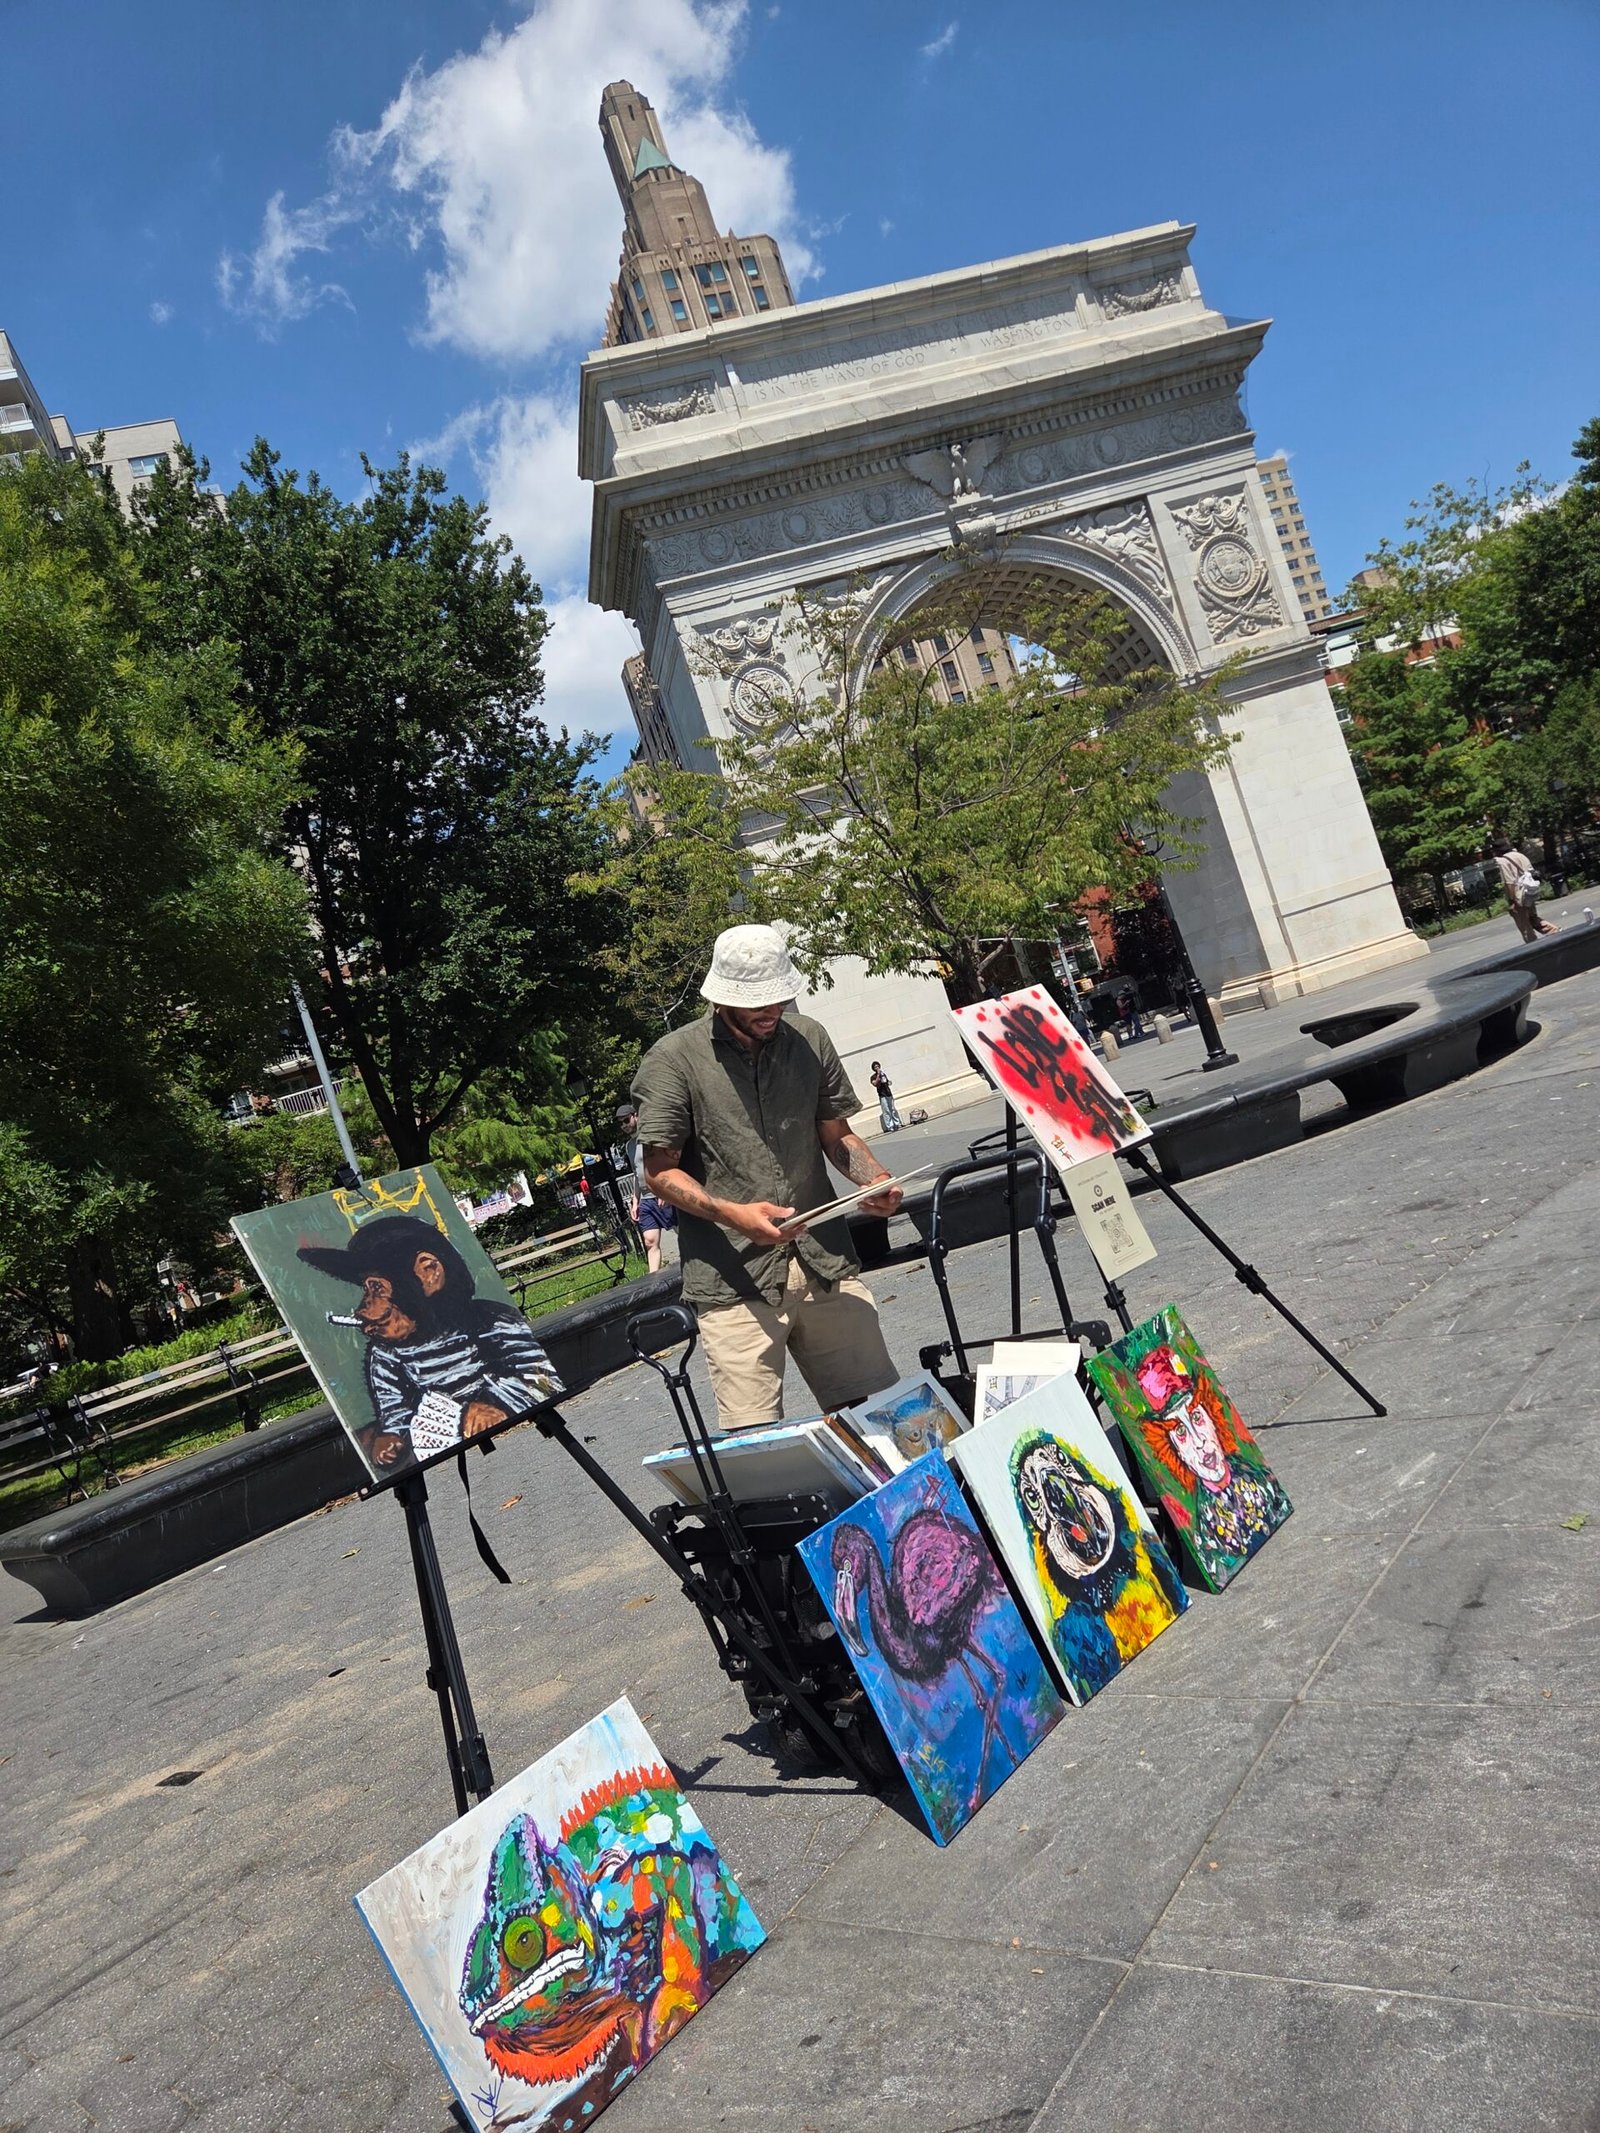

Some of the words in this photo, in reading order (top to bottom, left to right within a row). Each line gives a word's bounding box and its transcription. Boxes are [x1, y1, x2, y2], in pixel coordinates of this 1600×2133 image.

[754, 389, 766, 400] IS
[771, 384, 785, 397] IN
[789, 376, 819, 392] THE
[825, 366, 865, 384] HAND
[871, 360, 889, 373] OF
[895, 352, 924, 368] GOD
[980, 318, 1072, 348] WASHINGTON
[796, 346, 835, 365] RAISE
[1091, 1201, 1105, 1213] SCAN
[1103, 1195, 1116, 1208] HERE
